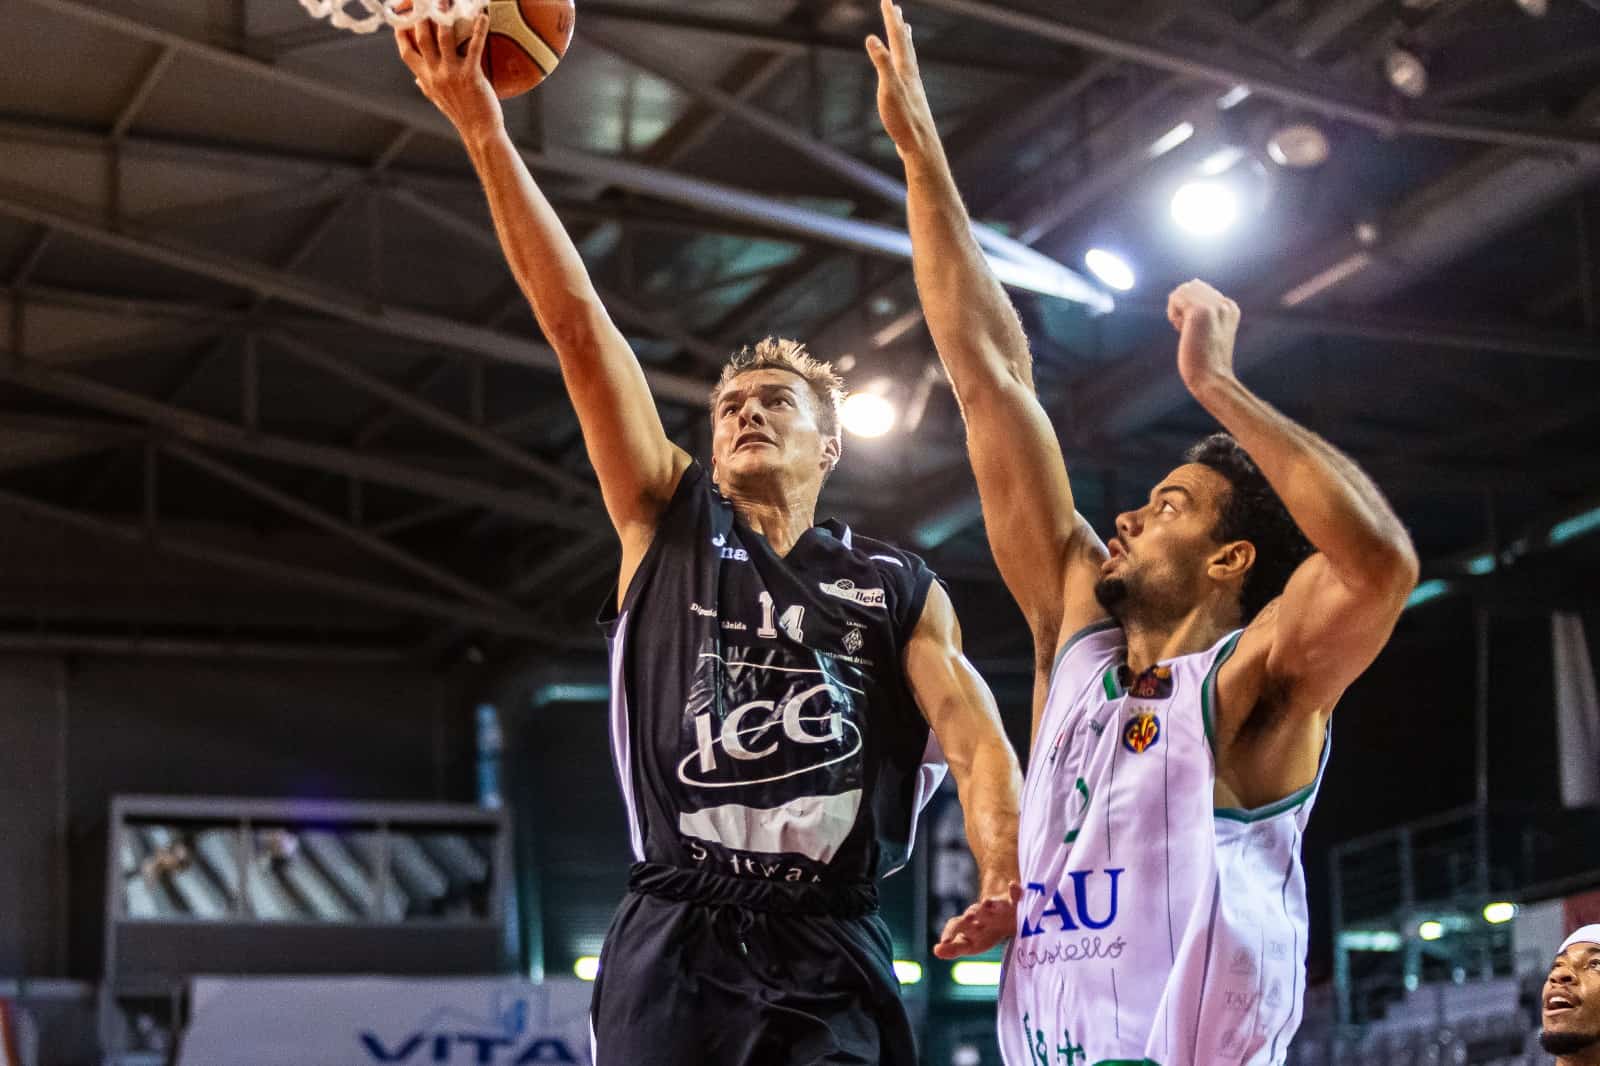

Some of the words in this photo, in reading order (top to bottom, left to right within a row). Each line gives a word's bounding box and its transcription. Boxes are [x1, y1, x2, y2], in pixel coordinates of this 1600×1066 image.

[757, 591, 805, 642] 14
[694, 683, 843, 774] ICG
[690, 842, 822, 882] Sftwa
[1021, 868, 1126, 938] TAU
